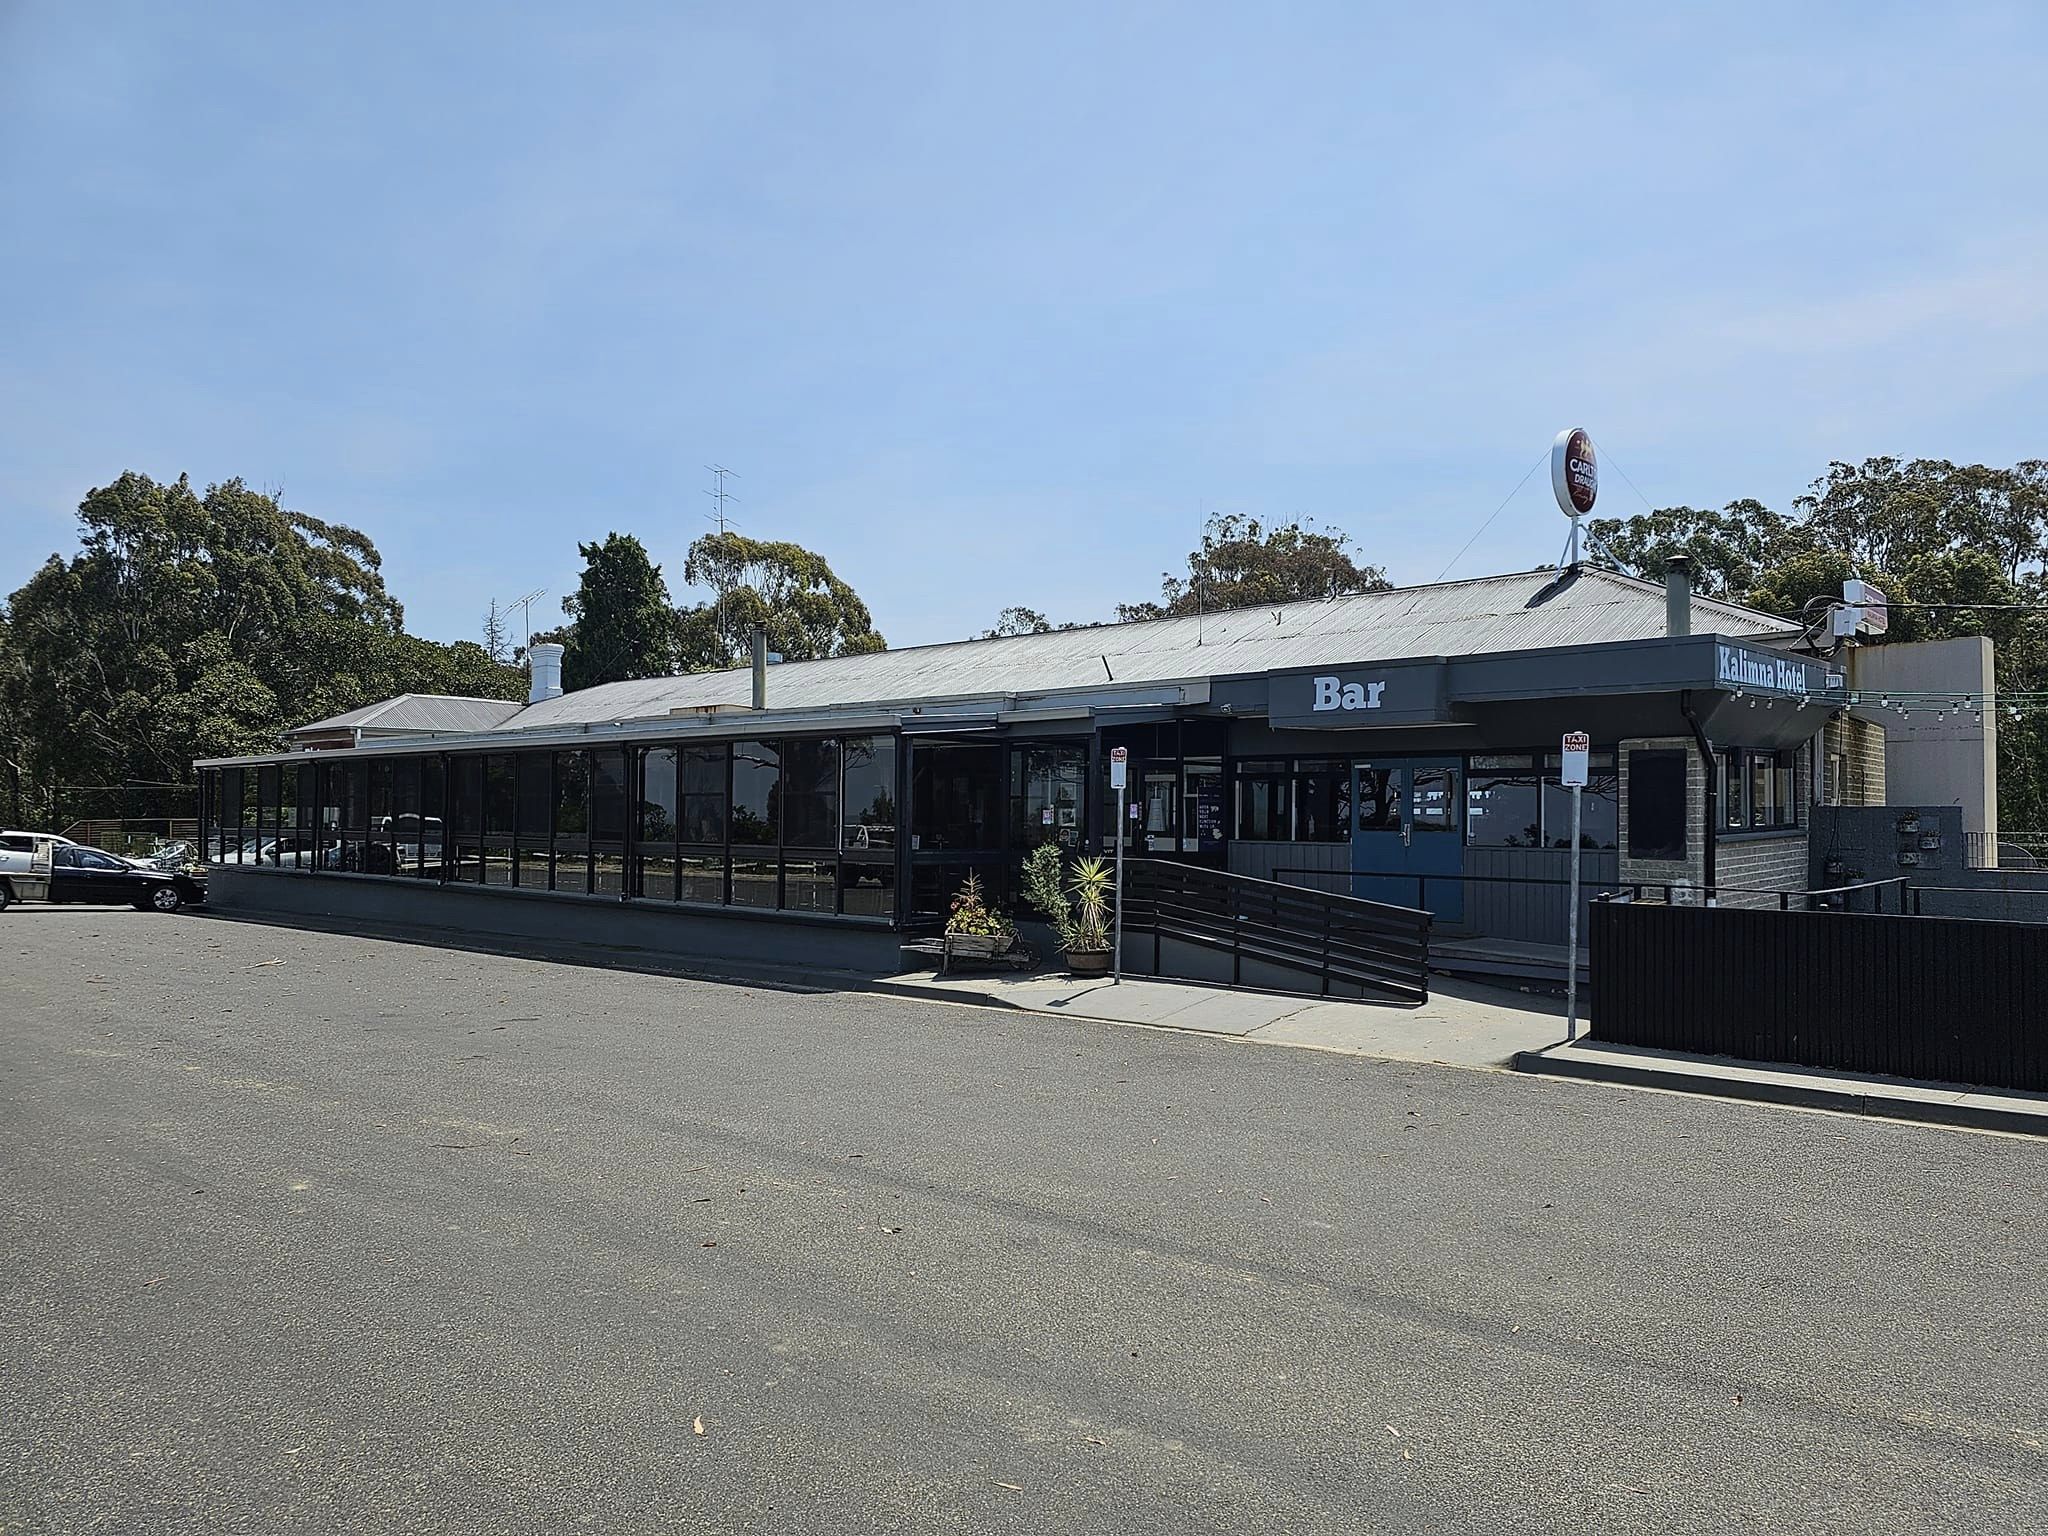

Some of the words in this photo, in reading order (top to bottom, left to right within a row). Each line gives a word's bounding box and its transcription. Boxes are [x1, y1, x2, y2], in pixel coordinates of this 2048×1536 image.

[1719, 645, 1775, 688] Kalimna
[1776, 659, 1806, 693] Hotel
[1313, 676, 1386, 711] Bar
[1565, 743, 1588, 751] ZONE
[1566, 735, 1586, 743] TAXI
